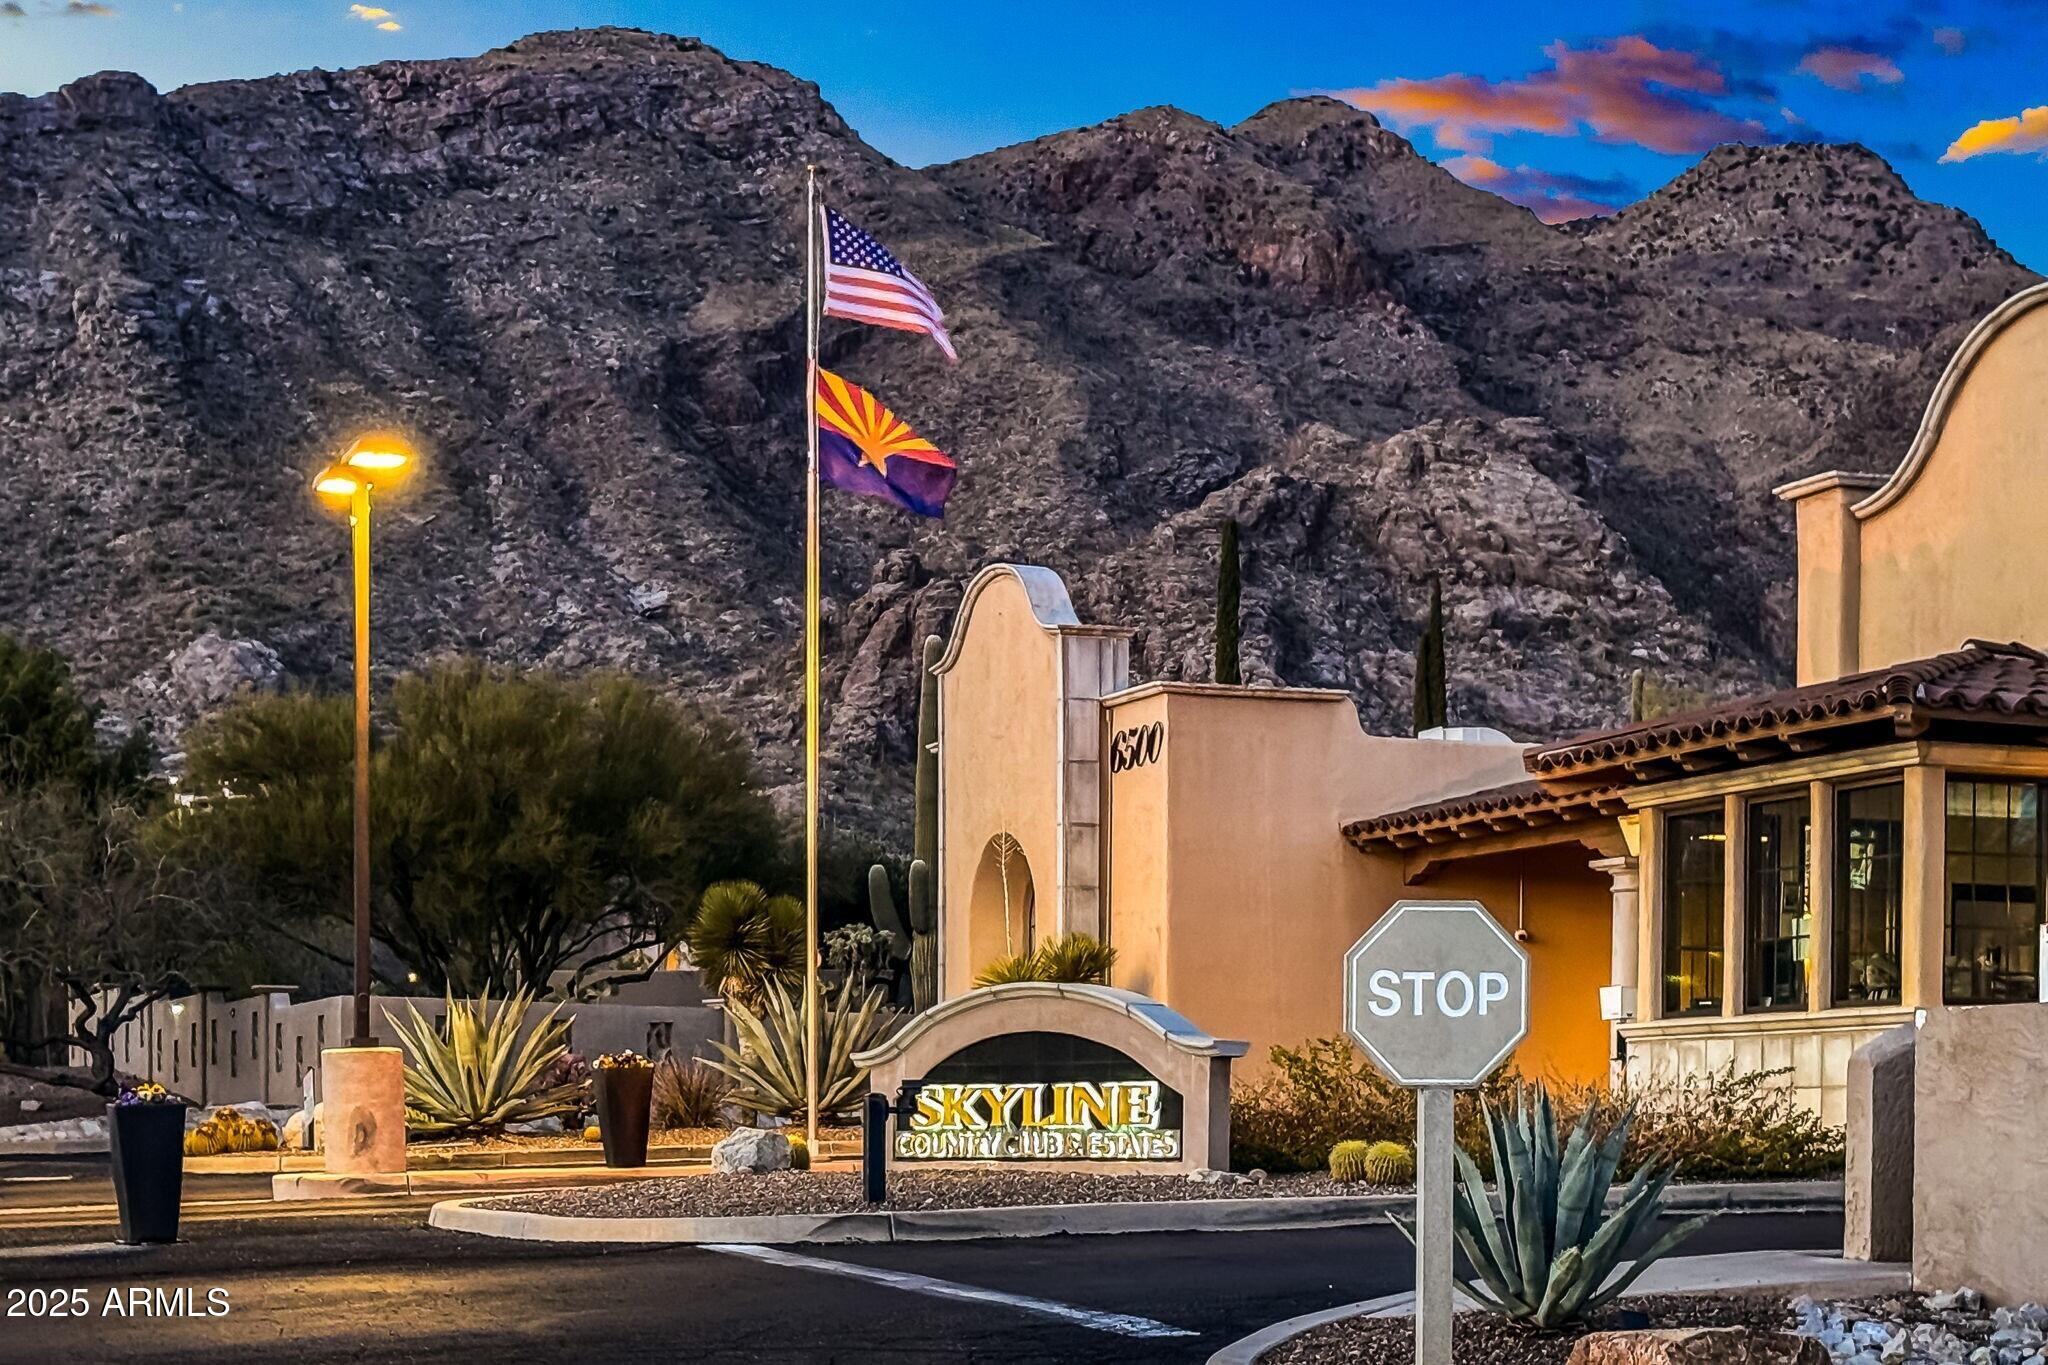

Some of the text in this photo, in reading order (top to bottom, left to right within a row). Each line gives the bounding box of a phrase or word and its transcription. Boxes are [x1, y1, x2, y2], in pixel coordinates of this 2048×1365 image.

[1110, 721, 1164, 773] 6500
[1368, 969, 1509, 1018] STOP
[910, 1083, 1159, 1130] SKYLINE
[896, 1131, 1001, 1158] COUNTRY
[1087, 1131, 1178, 1158] ESTATES
